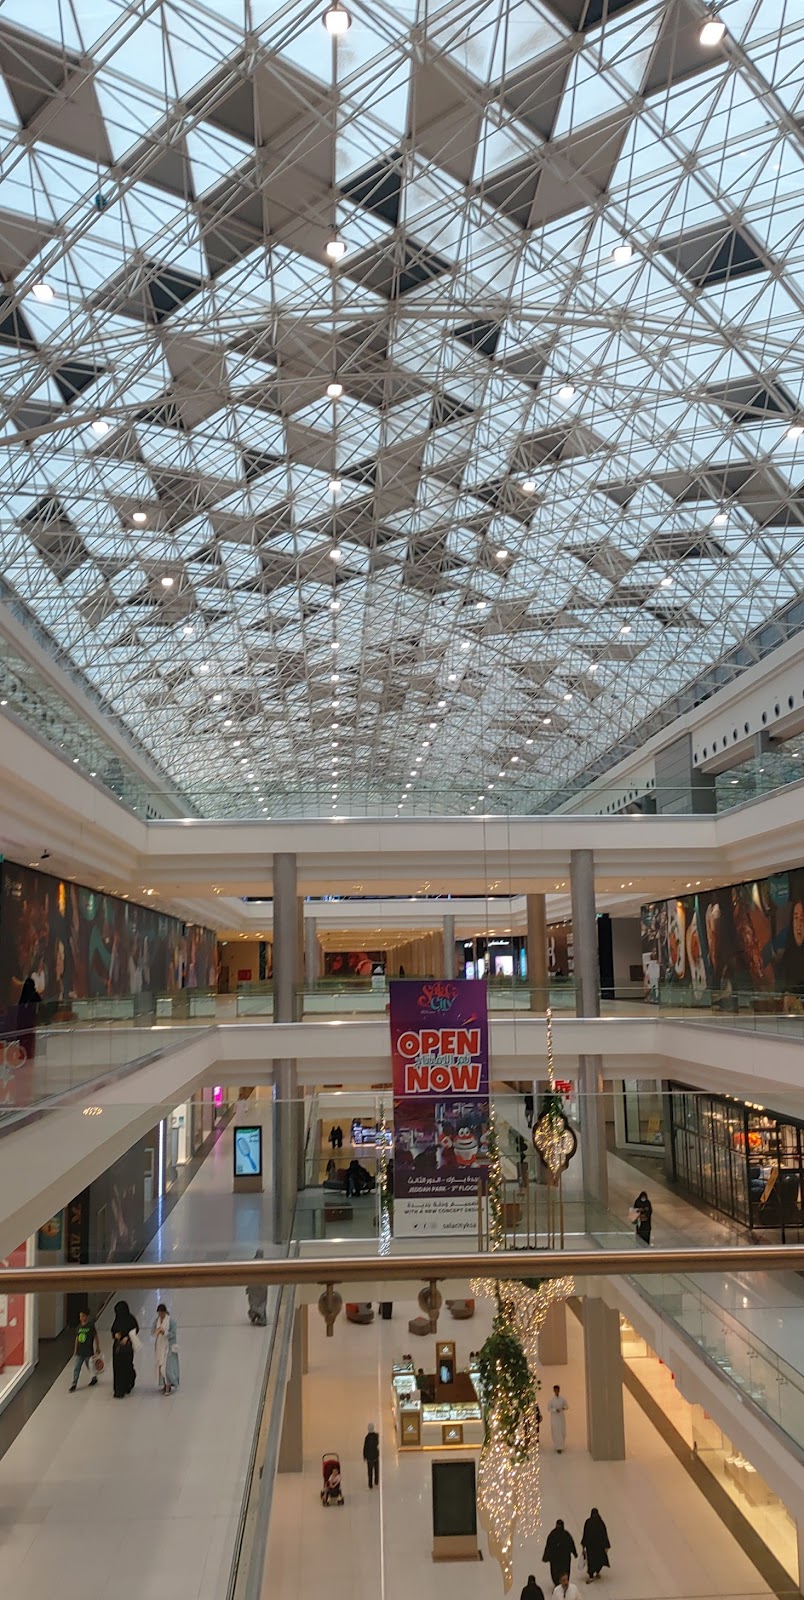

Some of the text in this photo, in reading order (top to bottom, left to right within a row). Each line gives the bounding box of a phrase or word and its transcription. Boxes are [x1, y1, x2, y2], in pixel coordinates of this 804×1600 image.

[397, 1029, 481, 1058] OPEN
[405, 1064, 482, 1093] NOW
[431, 1185, 447, 1193] PARK
